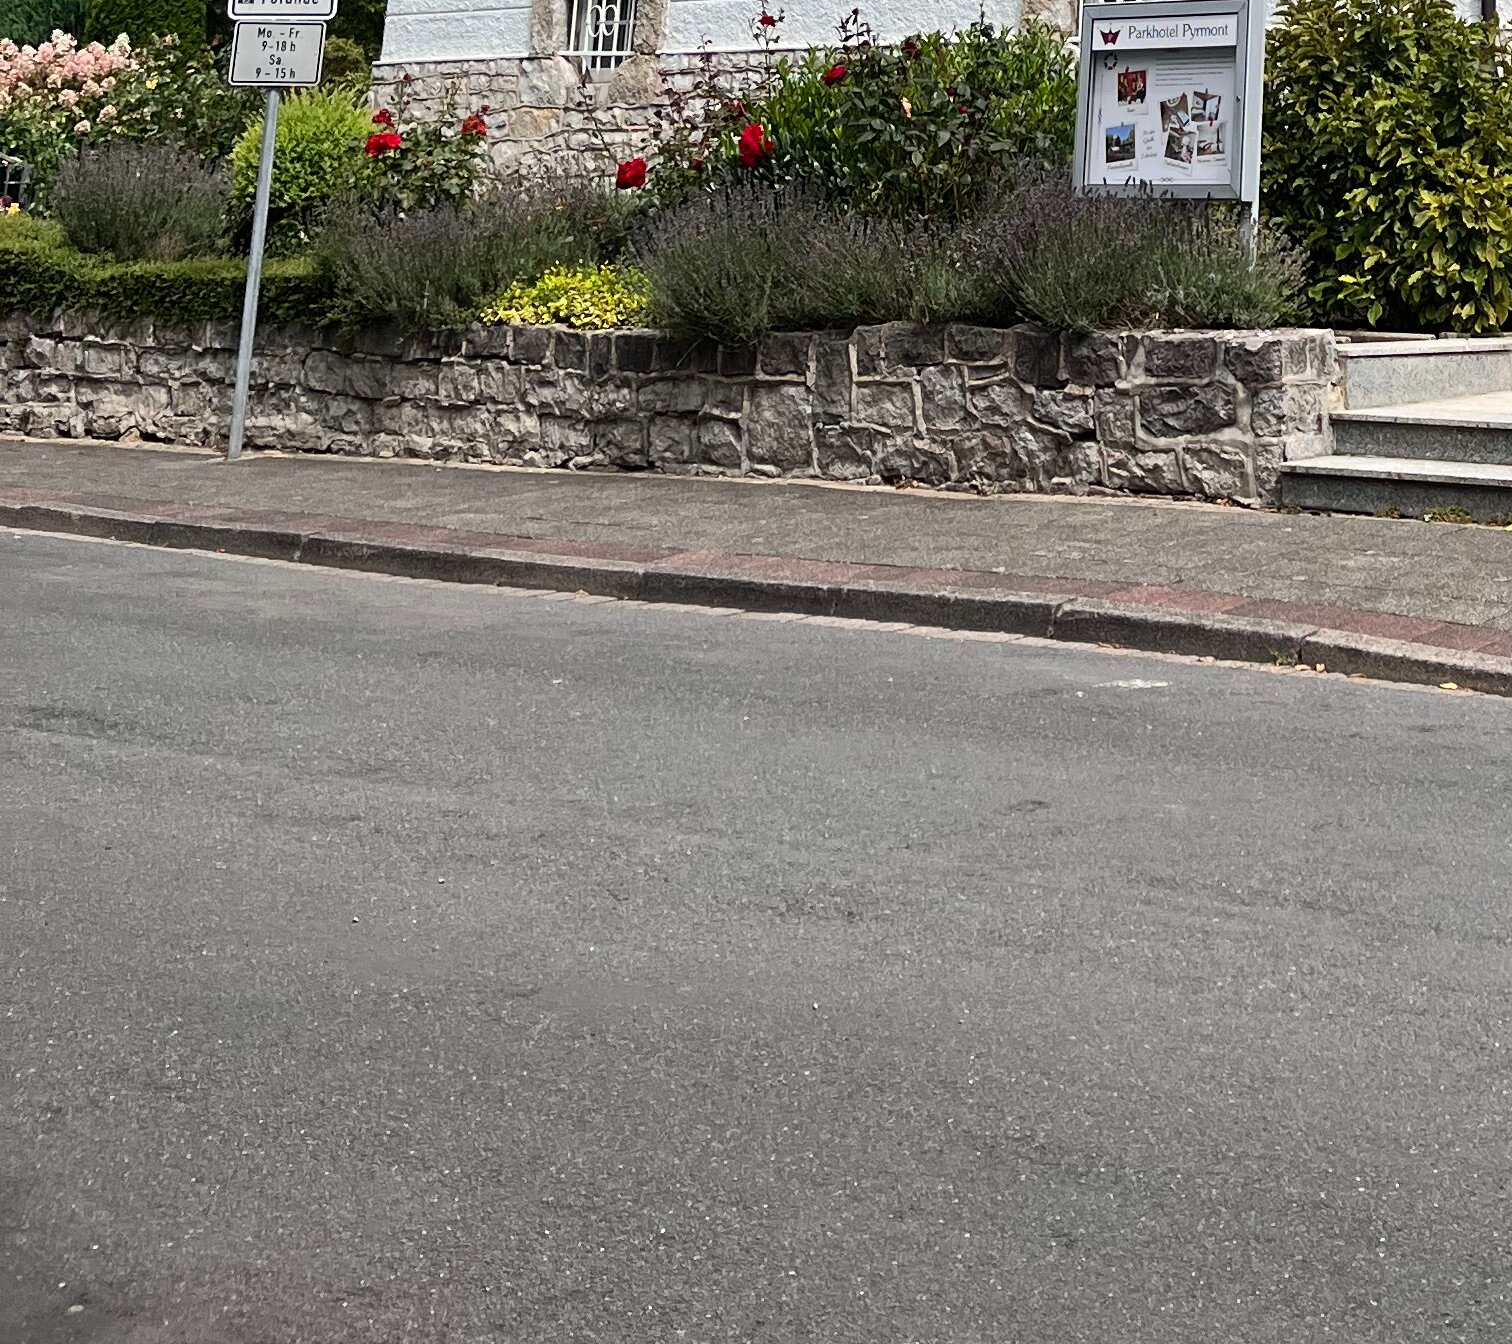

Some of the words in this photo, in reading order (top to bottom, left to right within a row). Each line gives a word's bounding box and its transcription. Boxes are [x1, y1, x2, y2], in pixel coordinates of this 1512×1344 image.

[1127, 23, 1179, 40] Parkhotel
[1182, 23, 1229, 41] Pyrmont
[289, 40, 296, 52] h
[255, 67, 262, 79] 9
[275, 67, 287, 79] 15
[289, 67, 296, 79] h
